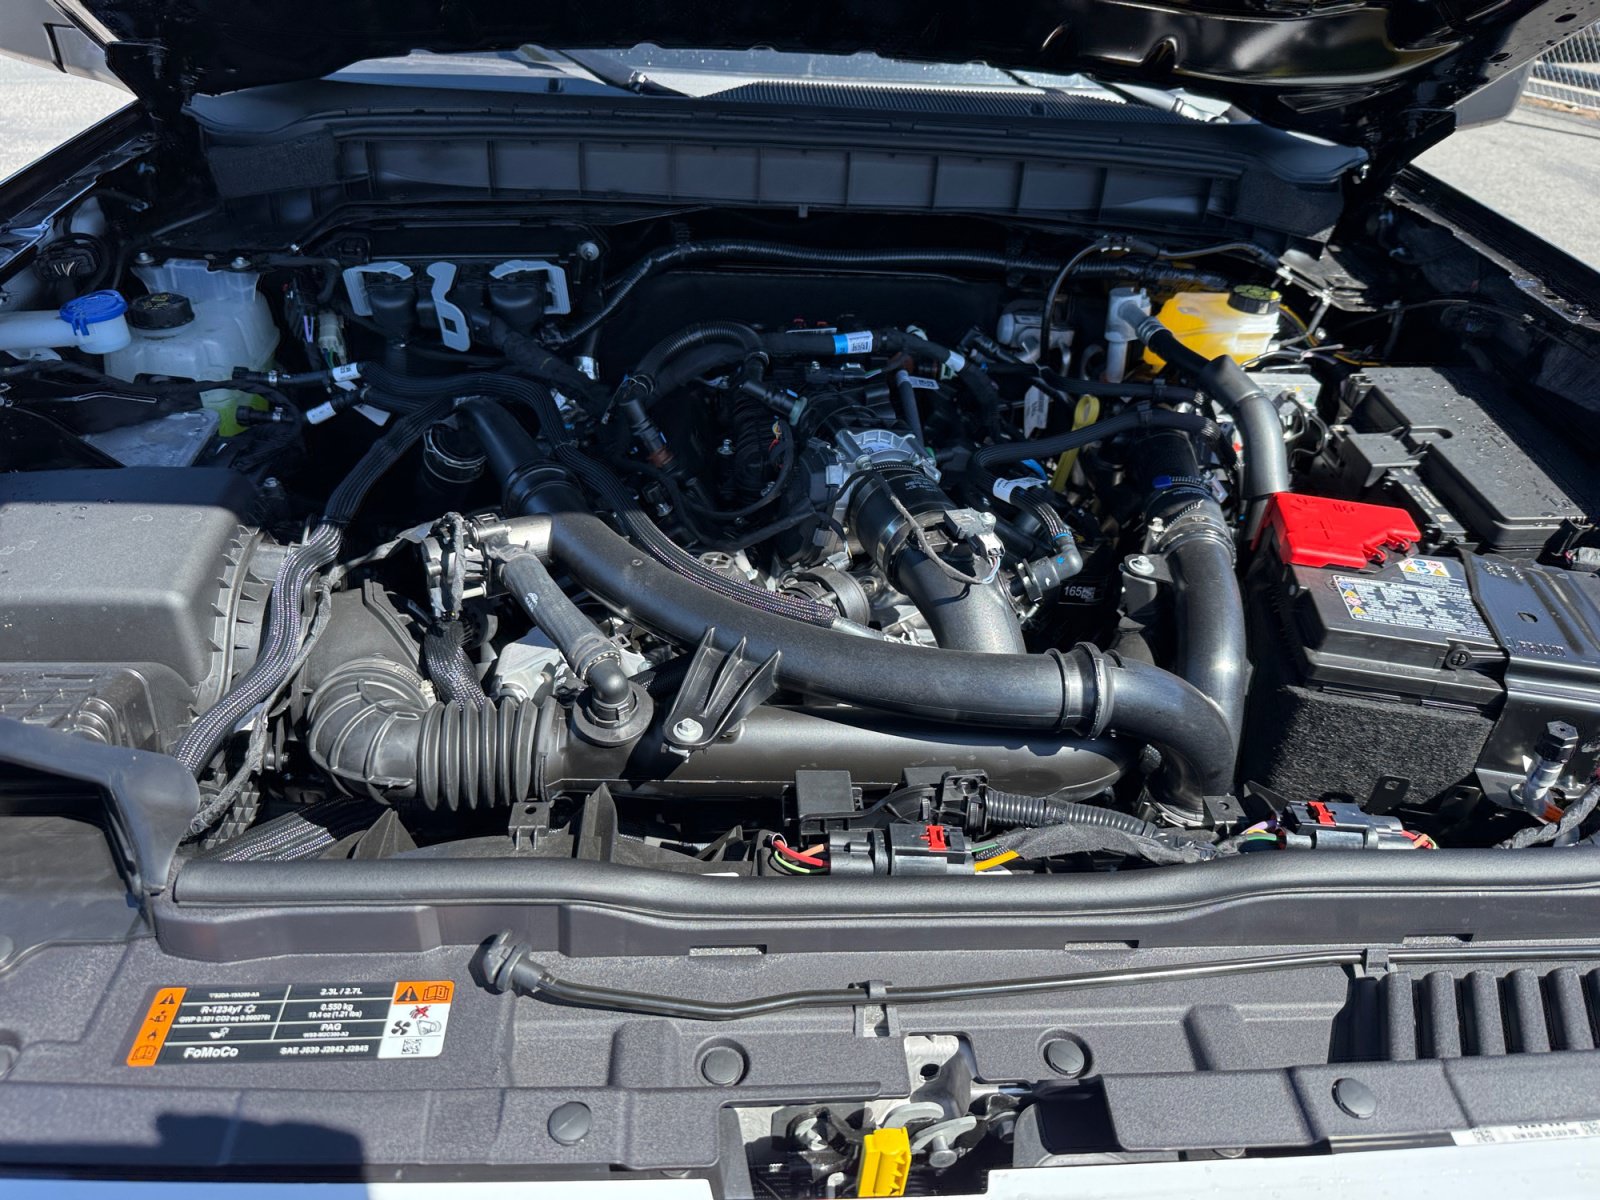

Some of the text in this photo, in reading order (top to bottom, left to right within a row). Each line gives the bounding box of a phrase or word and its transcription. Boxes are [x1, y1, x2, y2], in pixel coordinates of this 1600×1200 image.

[320, 988, 339, 996] 2.3L
[345, 987, 363, 996] 2.7L
[320, 1003, 354, 1012] 0.550 kg
[320, 1023, 342, 1032] PAG
[183, 1046, 239, 1059] FoMoCo
[280, 1046, 299, 1055] SAE
